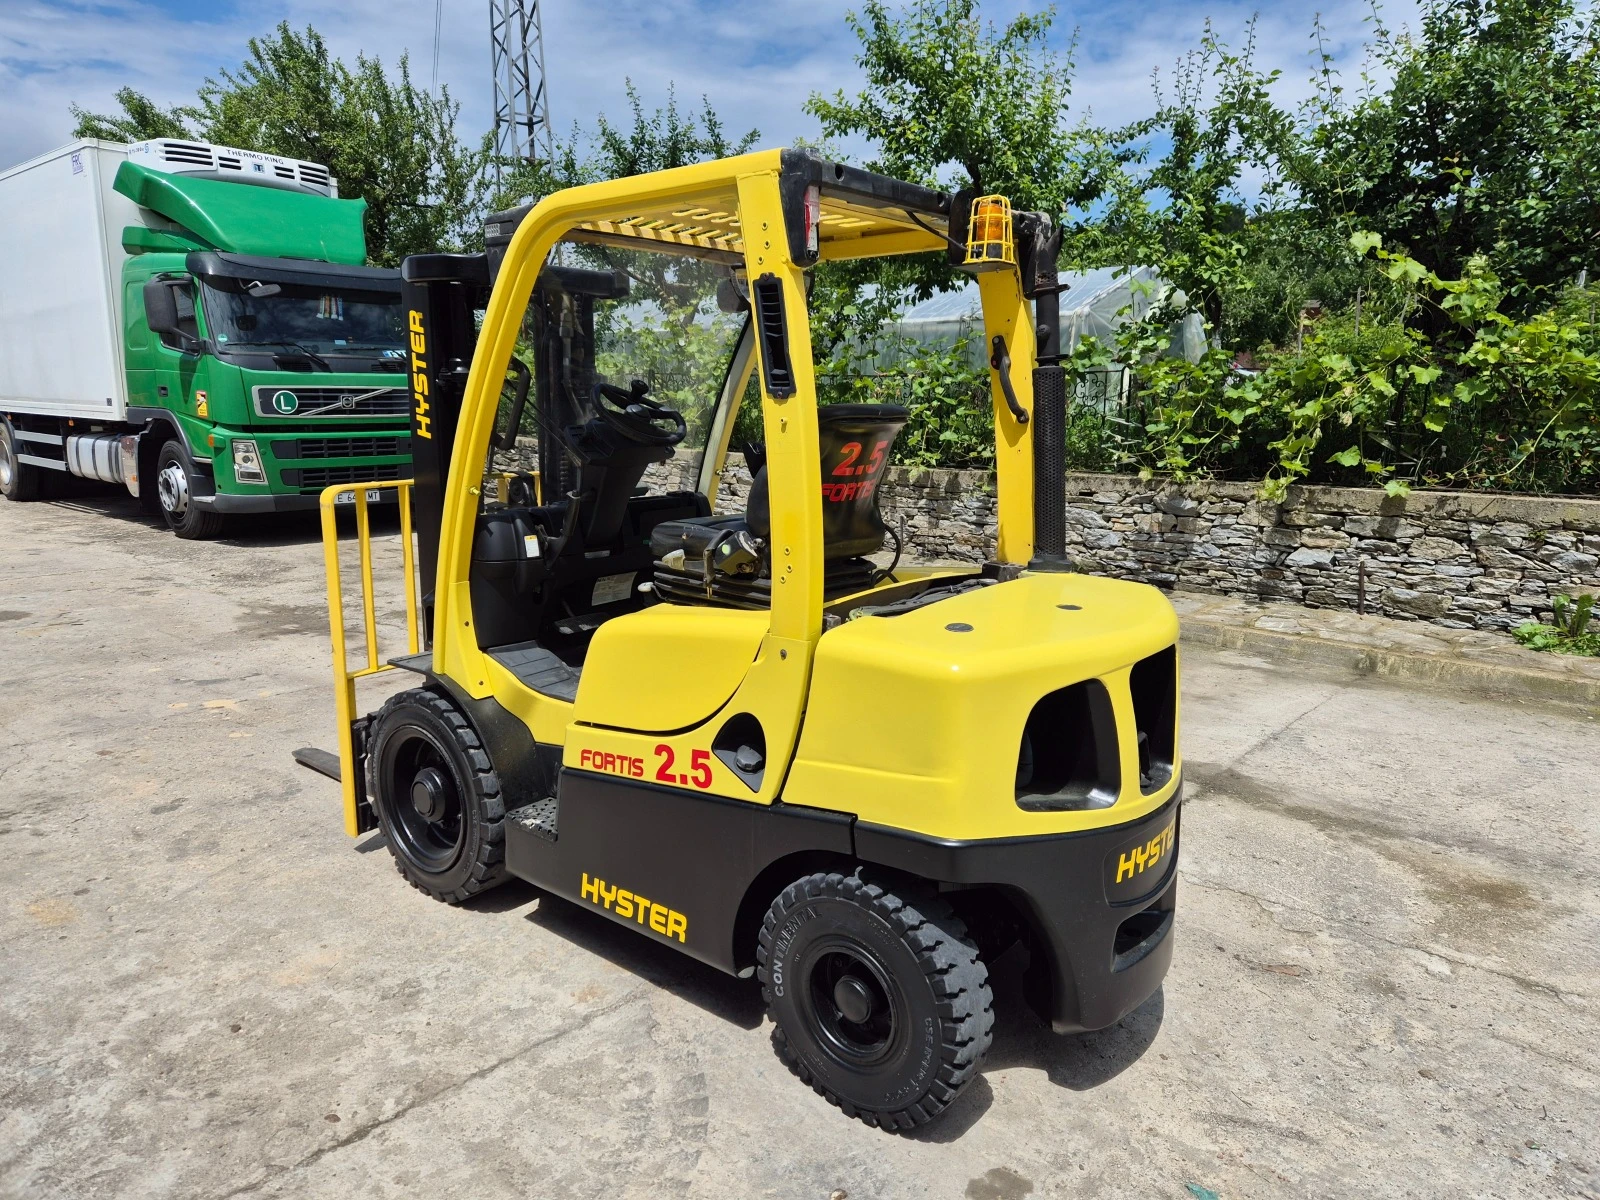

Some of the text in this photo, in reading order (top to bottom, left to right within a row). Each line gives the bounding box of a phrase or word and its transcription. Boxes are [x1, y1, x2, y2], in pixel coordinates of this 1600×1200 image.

[226, 149, 284, 165] THERMO KING
[409, 310, 432, 440] HYSTER
[831, 440, 888, 476] 2.5
[337, 494, 344, 503] E
[367, 491, 378, 500] MT
[822, 479, 876, 502] FORTIS
[580, 744, 713, 789] FORTIS 2.5
[1116, 816, 1176, 884] HYSTE
[581, 872, 688, 943] HYSTER
